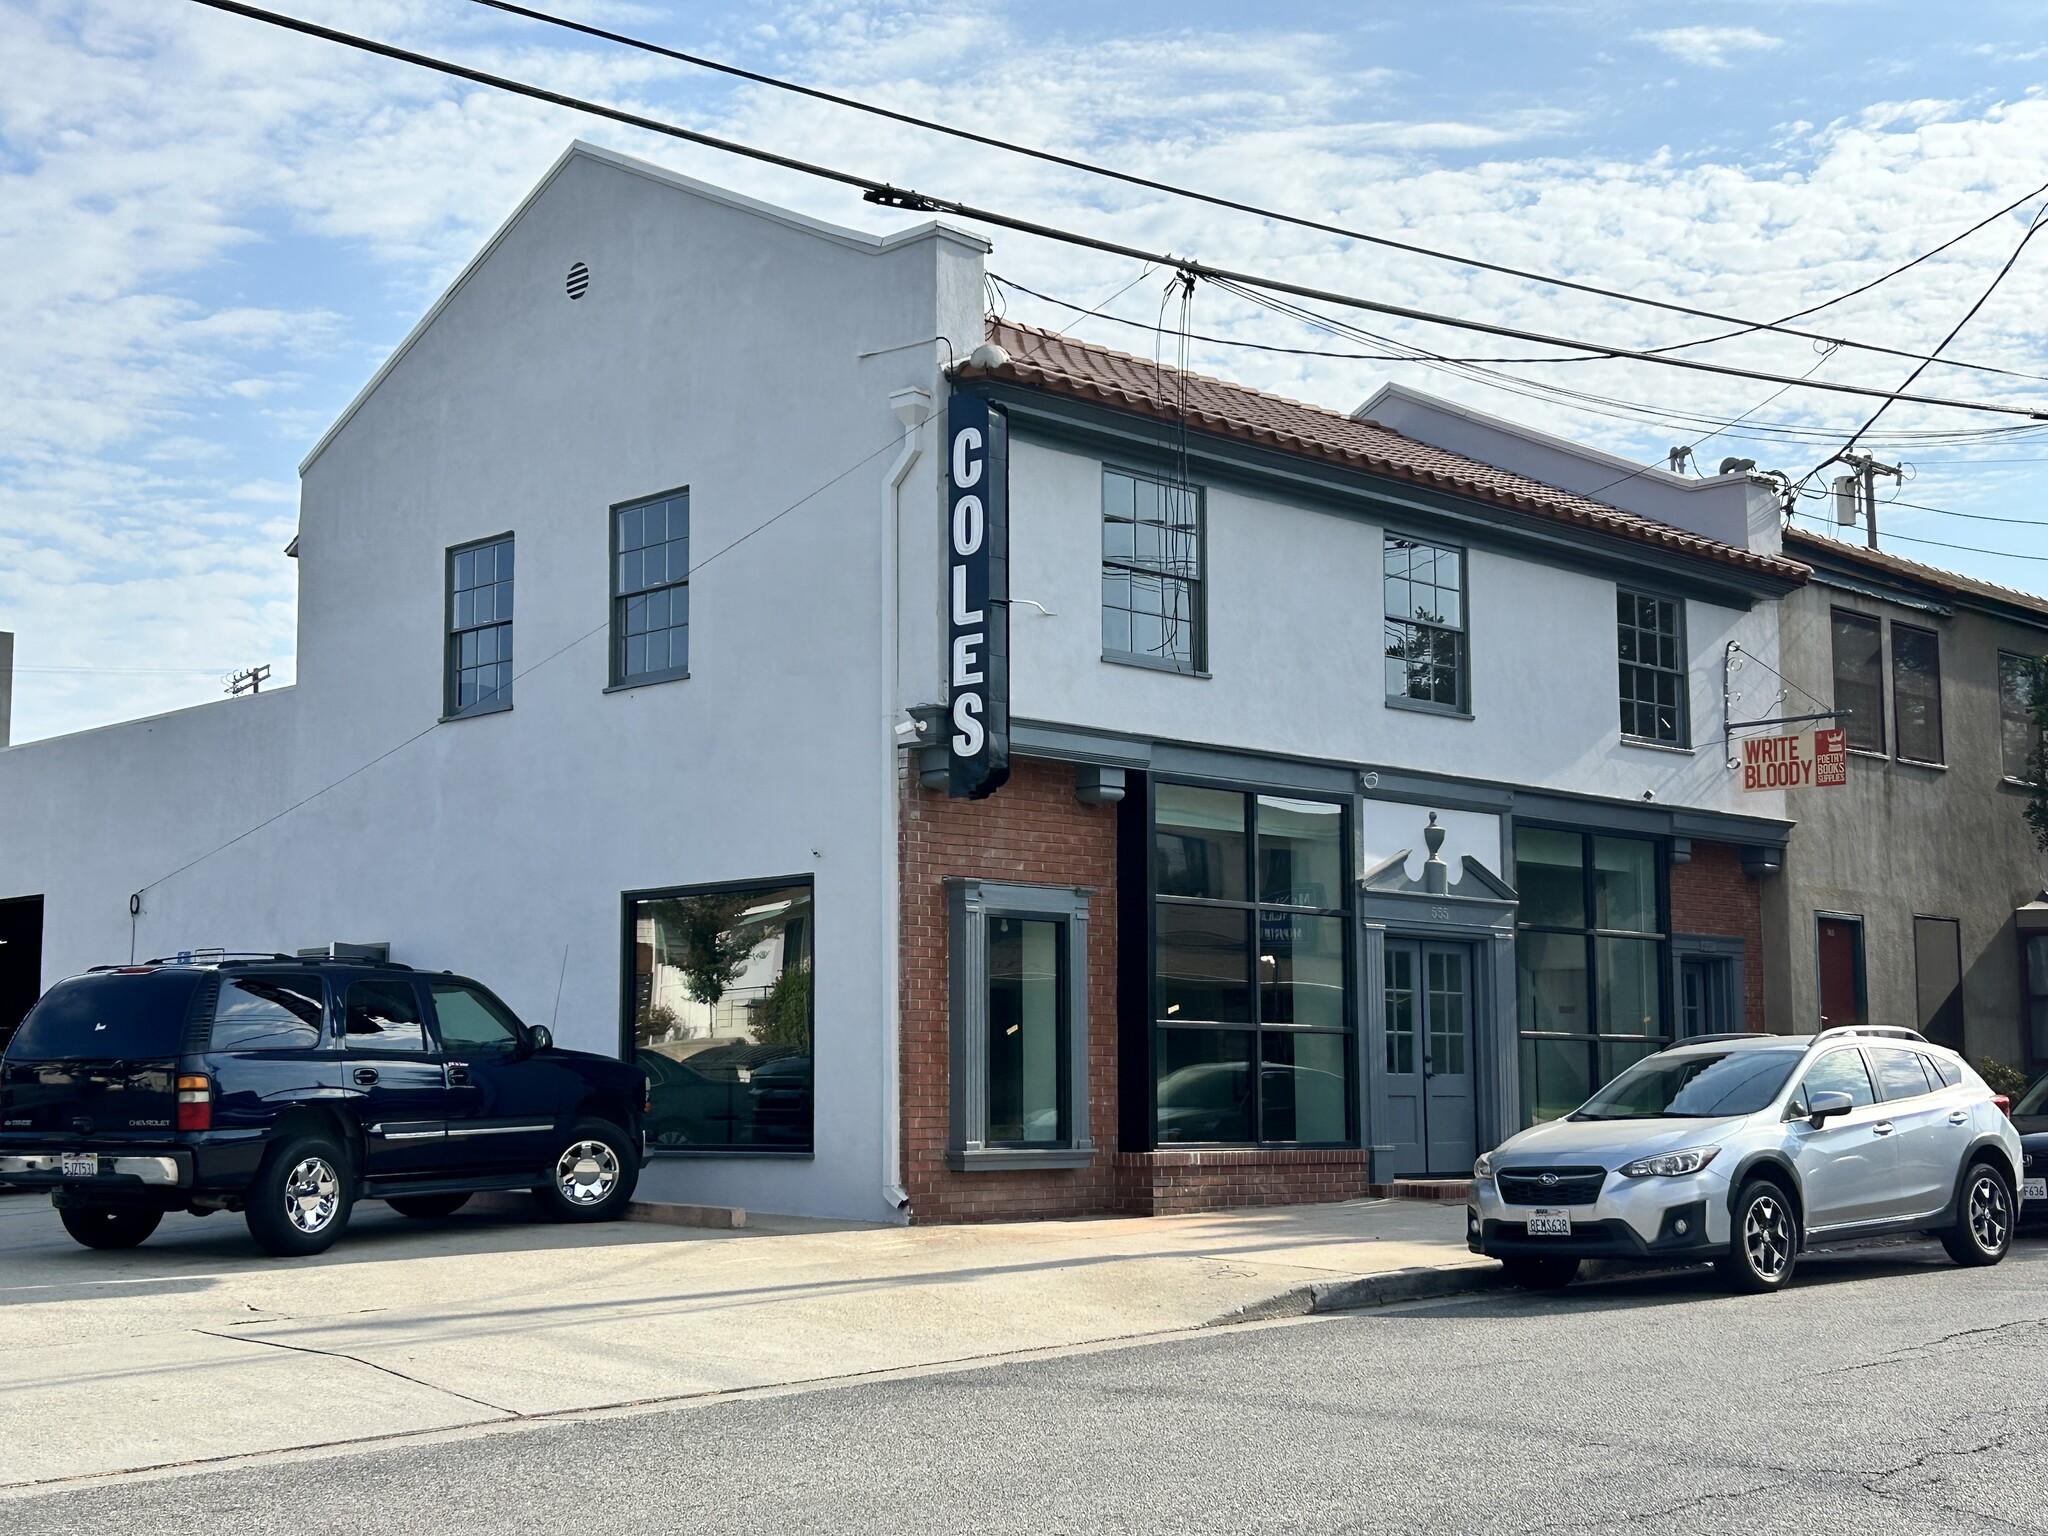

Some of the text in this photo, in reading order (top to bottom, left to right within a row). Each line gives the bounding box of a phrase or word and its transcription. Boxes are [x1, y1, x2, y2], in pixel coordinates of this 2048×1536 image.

[952, 427, 984, 758] COLES
[1744, 736, 1800, 764] WRITE
[1817, 752, 1844, 764] POETRY
[1744, 760, 1813, 789] BLOODY
[1817, 762, 1845, 775] BOOKS
[1817, 773, 1845, 783] SUPPLIES
[129, 1119, 171, 1127] CHEVROLET
